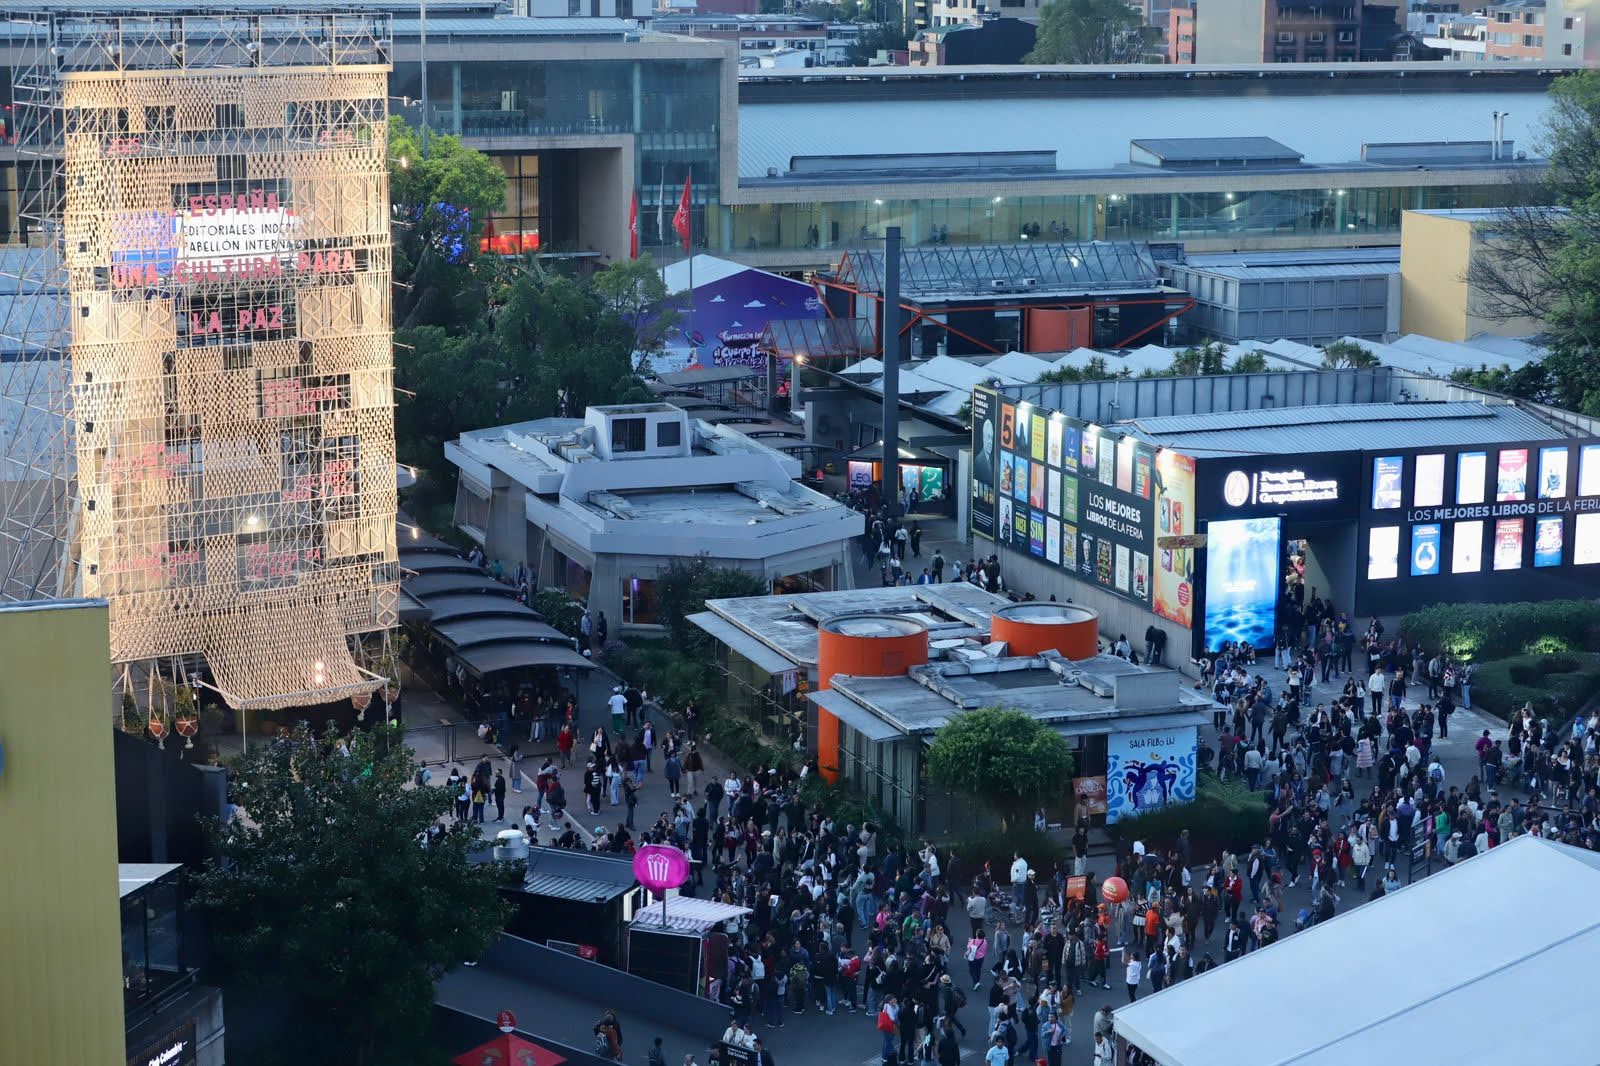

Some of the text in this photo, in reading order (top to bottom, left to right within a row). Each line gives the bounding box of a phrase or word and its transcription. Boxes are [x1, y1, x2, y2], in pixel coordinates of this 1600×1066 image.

[190, 188, 279, 217] ESPAÑA
[183, 224, 255, 236] EDITORIALES
[113, 251, 355, 287] UNA CULTURA PARA
[192, 306, 283, 334] LA PAZ
[721, 347, 751, 360] Cuerpo
[1003, 414, 1011, 445] 5
[1089, 492, 1104, 509] LOS
[1105, 498, 1141, 523] MEJORES
[1407, 509, 1431, 522] LOS
[1434, 506, 1490, 520] MEJORES
[1492, 503, 1535, 517] LIBROS
[1538, 501, 1554, 513] DE
[1556, 500, 1571, 511] LA
[1030, 520, 1044, 543] SIN
[1086, 509, 1144, 540] LIBROS DE LA FERIA
[1129, 739, 1146, 749] SALA
